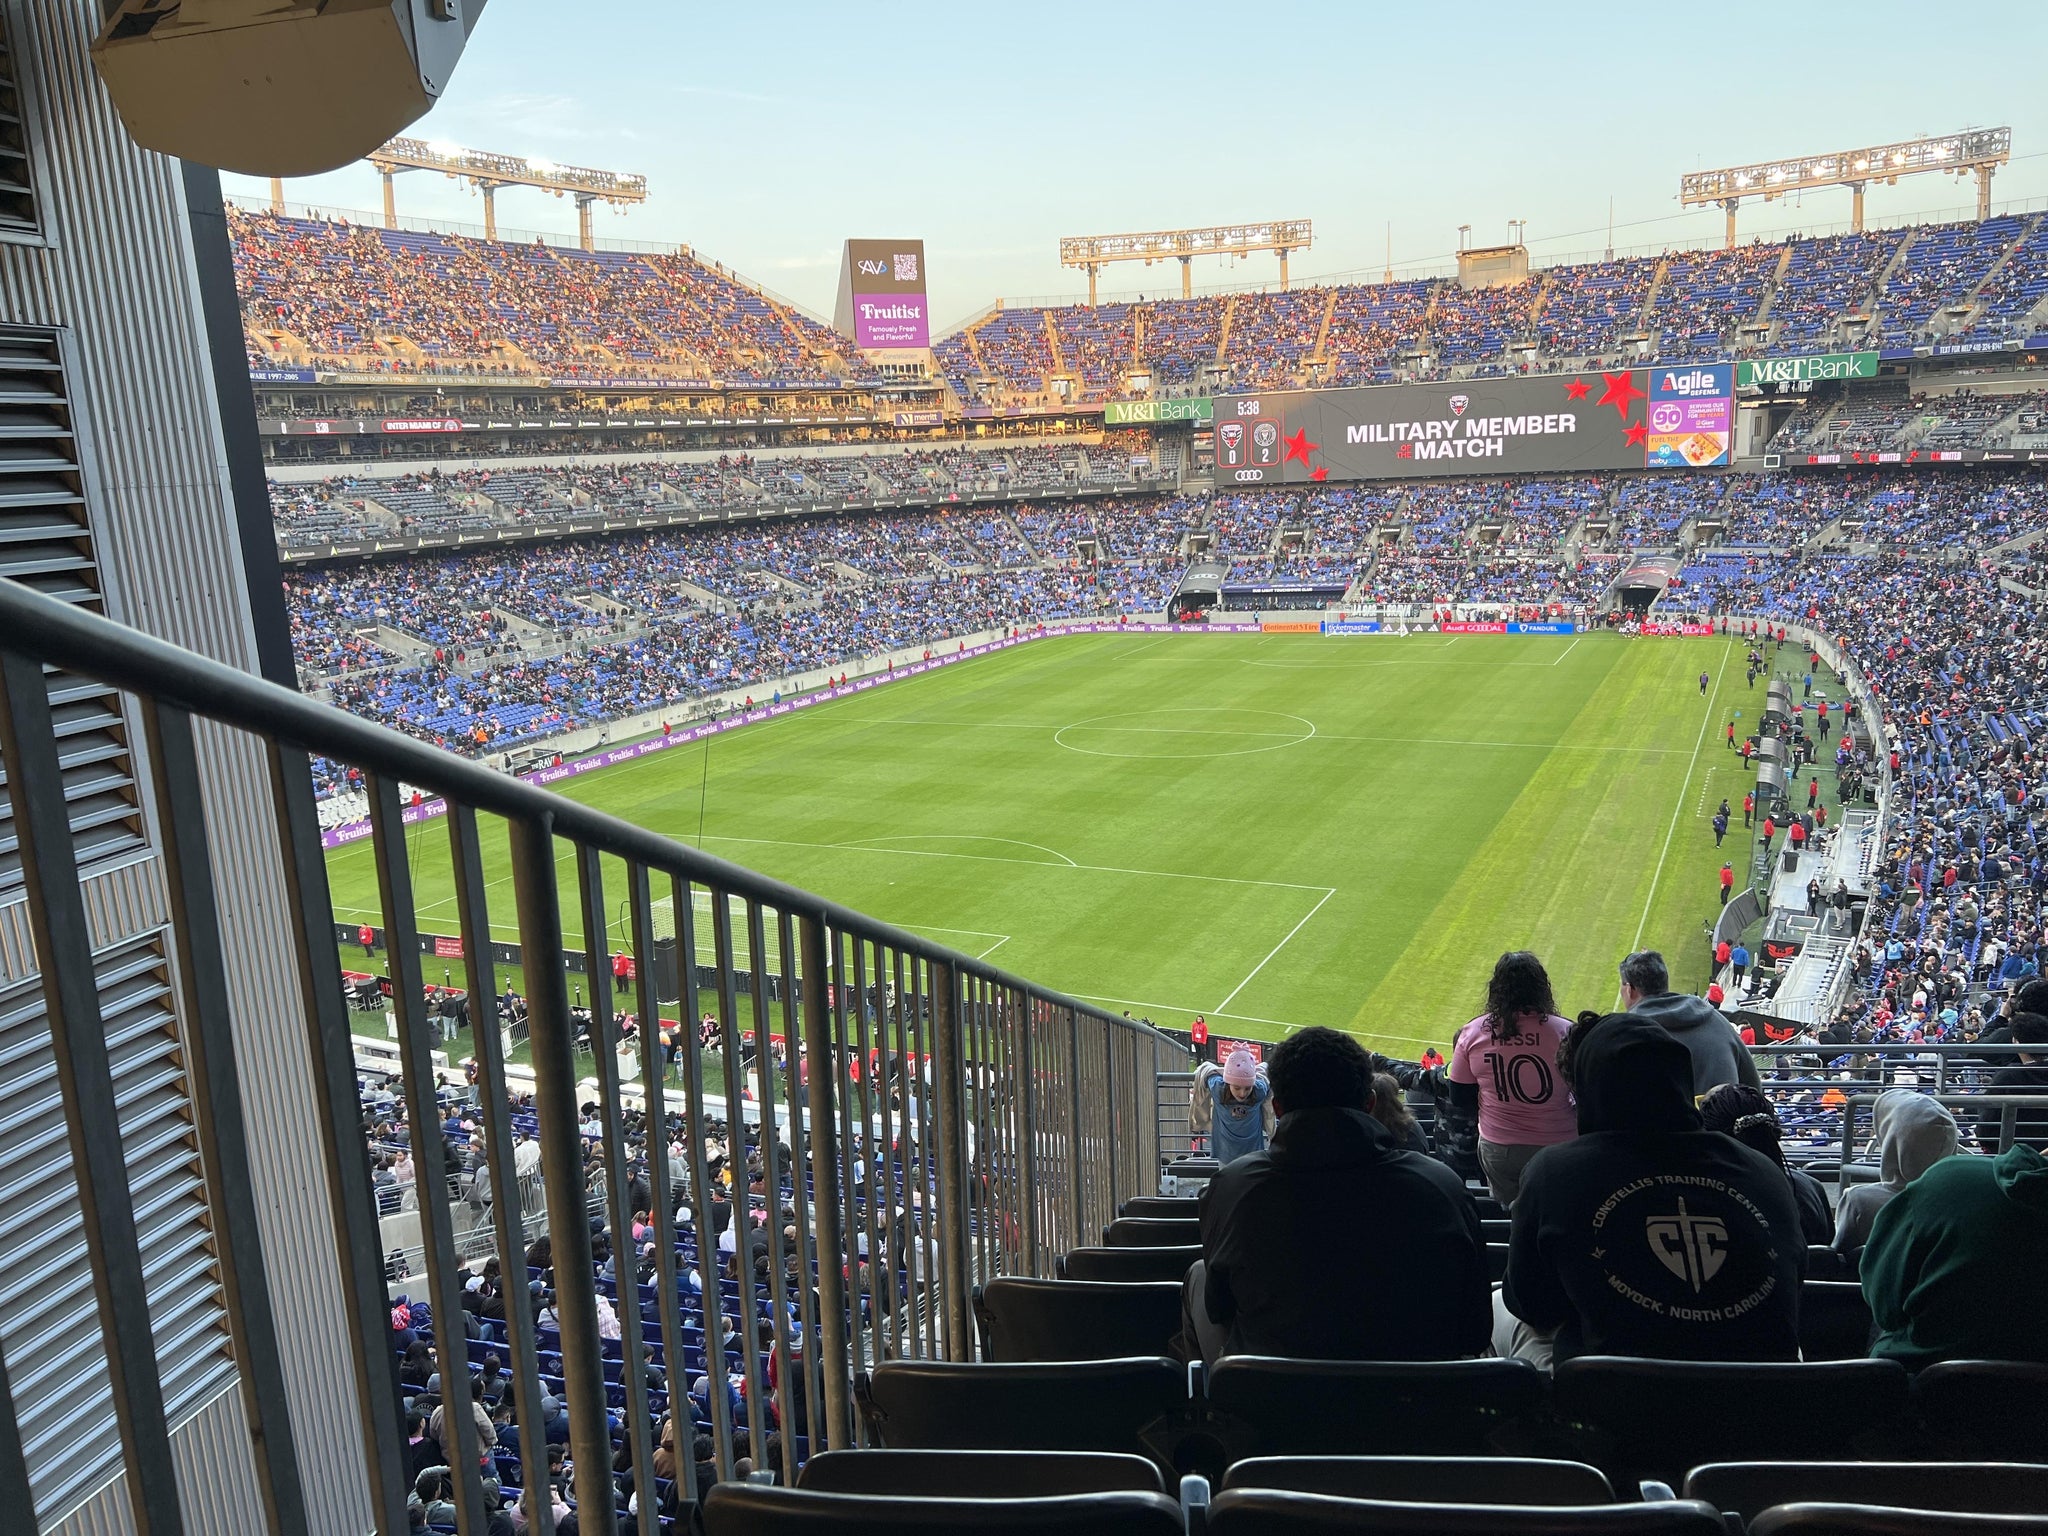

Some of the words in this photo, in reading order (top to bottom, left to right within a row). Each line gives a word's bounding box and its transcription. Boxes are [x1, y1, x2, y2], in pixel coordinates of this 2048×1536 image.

[860, 303, 921, 319] Fruitist
[868, 325, 898, 334] Famously
[886, 333, 914, 341] Flavorful
[1750, 359, 1806, 383] M&T
[1807, 355, 1863, 378] Bank
[1661, 370, 1715, 395] Agile
[1690, 388, 1721, 396] DEFENSE
[1115, 402, 1159, 422] M&T
[1160, 400, 1202, 420] Bank
[1238, 400, 1260, 416] 5:38
[1655, 410, 1681, 425] 90
[281, 422, 287, 434] 0
[359, 422, 365, 433] 2
[387, 421, 409, 430] INTER
[409, 421, 432, 430] MIAMI
[432, 421, 442, 429] CF
[1347, 419, 1459, 443] MILITARY
[1466, 413, 1576, 437] MEMBER
[1414, 437, 1503, 460] MATCH
[1659, 446, 1670, 454] 90
[1229, 450, 1236, 464] 0
[1262, 448, 1269, 463] 2
[1818, 454, 1841, 463] UNITED
[1879, 452, 1901, 461] UNITED
[1940, 451, 1962, 459] UNITED
[1045, 628, 1066, 637] Fruitist
[1070, 625, 1091, 633] Fruitist
[1095, 624, 1118, 632] Fruitist
[1122, 624, 1145, 633] Fruitist
[1150, 624, 1173, 633] Fruitist
[1179, 624, 1202, 633] Fruitist
[1207, 624, 1231, 633] Fruitist
[1236, 624, 1260, 633] Fruitist
[1263, 623, 1299, 631] Continental
[1305, 623, 1319, 631] Tire
[1328, 622, 1371, 632] ticketmaster
[836, 685, 854, 696] Fruitist
[792, 696, 811, 708] Fruitist
[814, 691, 833, 703] Fruitist
[770, 703, 790, 715] Fruitist
[746, 710, 767, 722] Fruitist
[721, 717, 743, 730] Fruitist
[695, 724, 718, 738] Fruitist
[667, 731, 691, 745] Fruitist
[639, 740, 663, 754] Fruitist
[608, 749, 634, 762] Fruitist
[573, 758, 602, 772] Fruitist
[540, 767, 569, 783] Fruitist
[1484, 1052, 1554, 1105] 10
[1592, 1177, 1654, 1228] CONSTELLIS
[1656, 1175, 1726, 1192] TRAINING
[1727, 1186, 1769, 1229] CENTER
[1607, 1275, 1664, 1314] MOYOCK,
[1669, 1307, 1722, 1322] NORTH
[1724, 1275, 1777, 1319] CAROLINA
